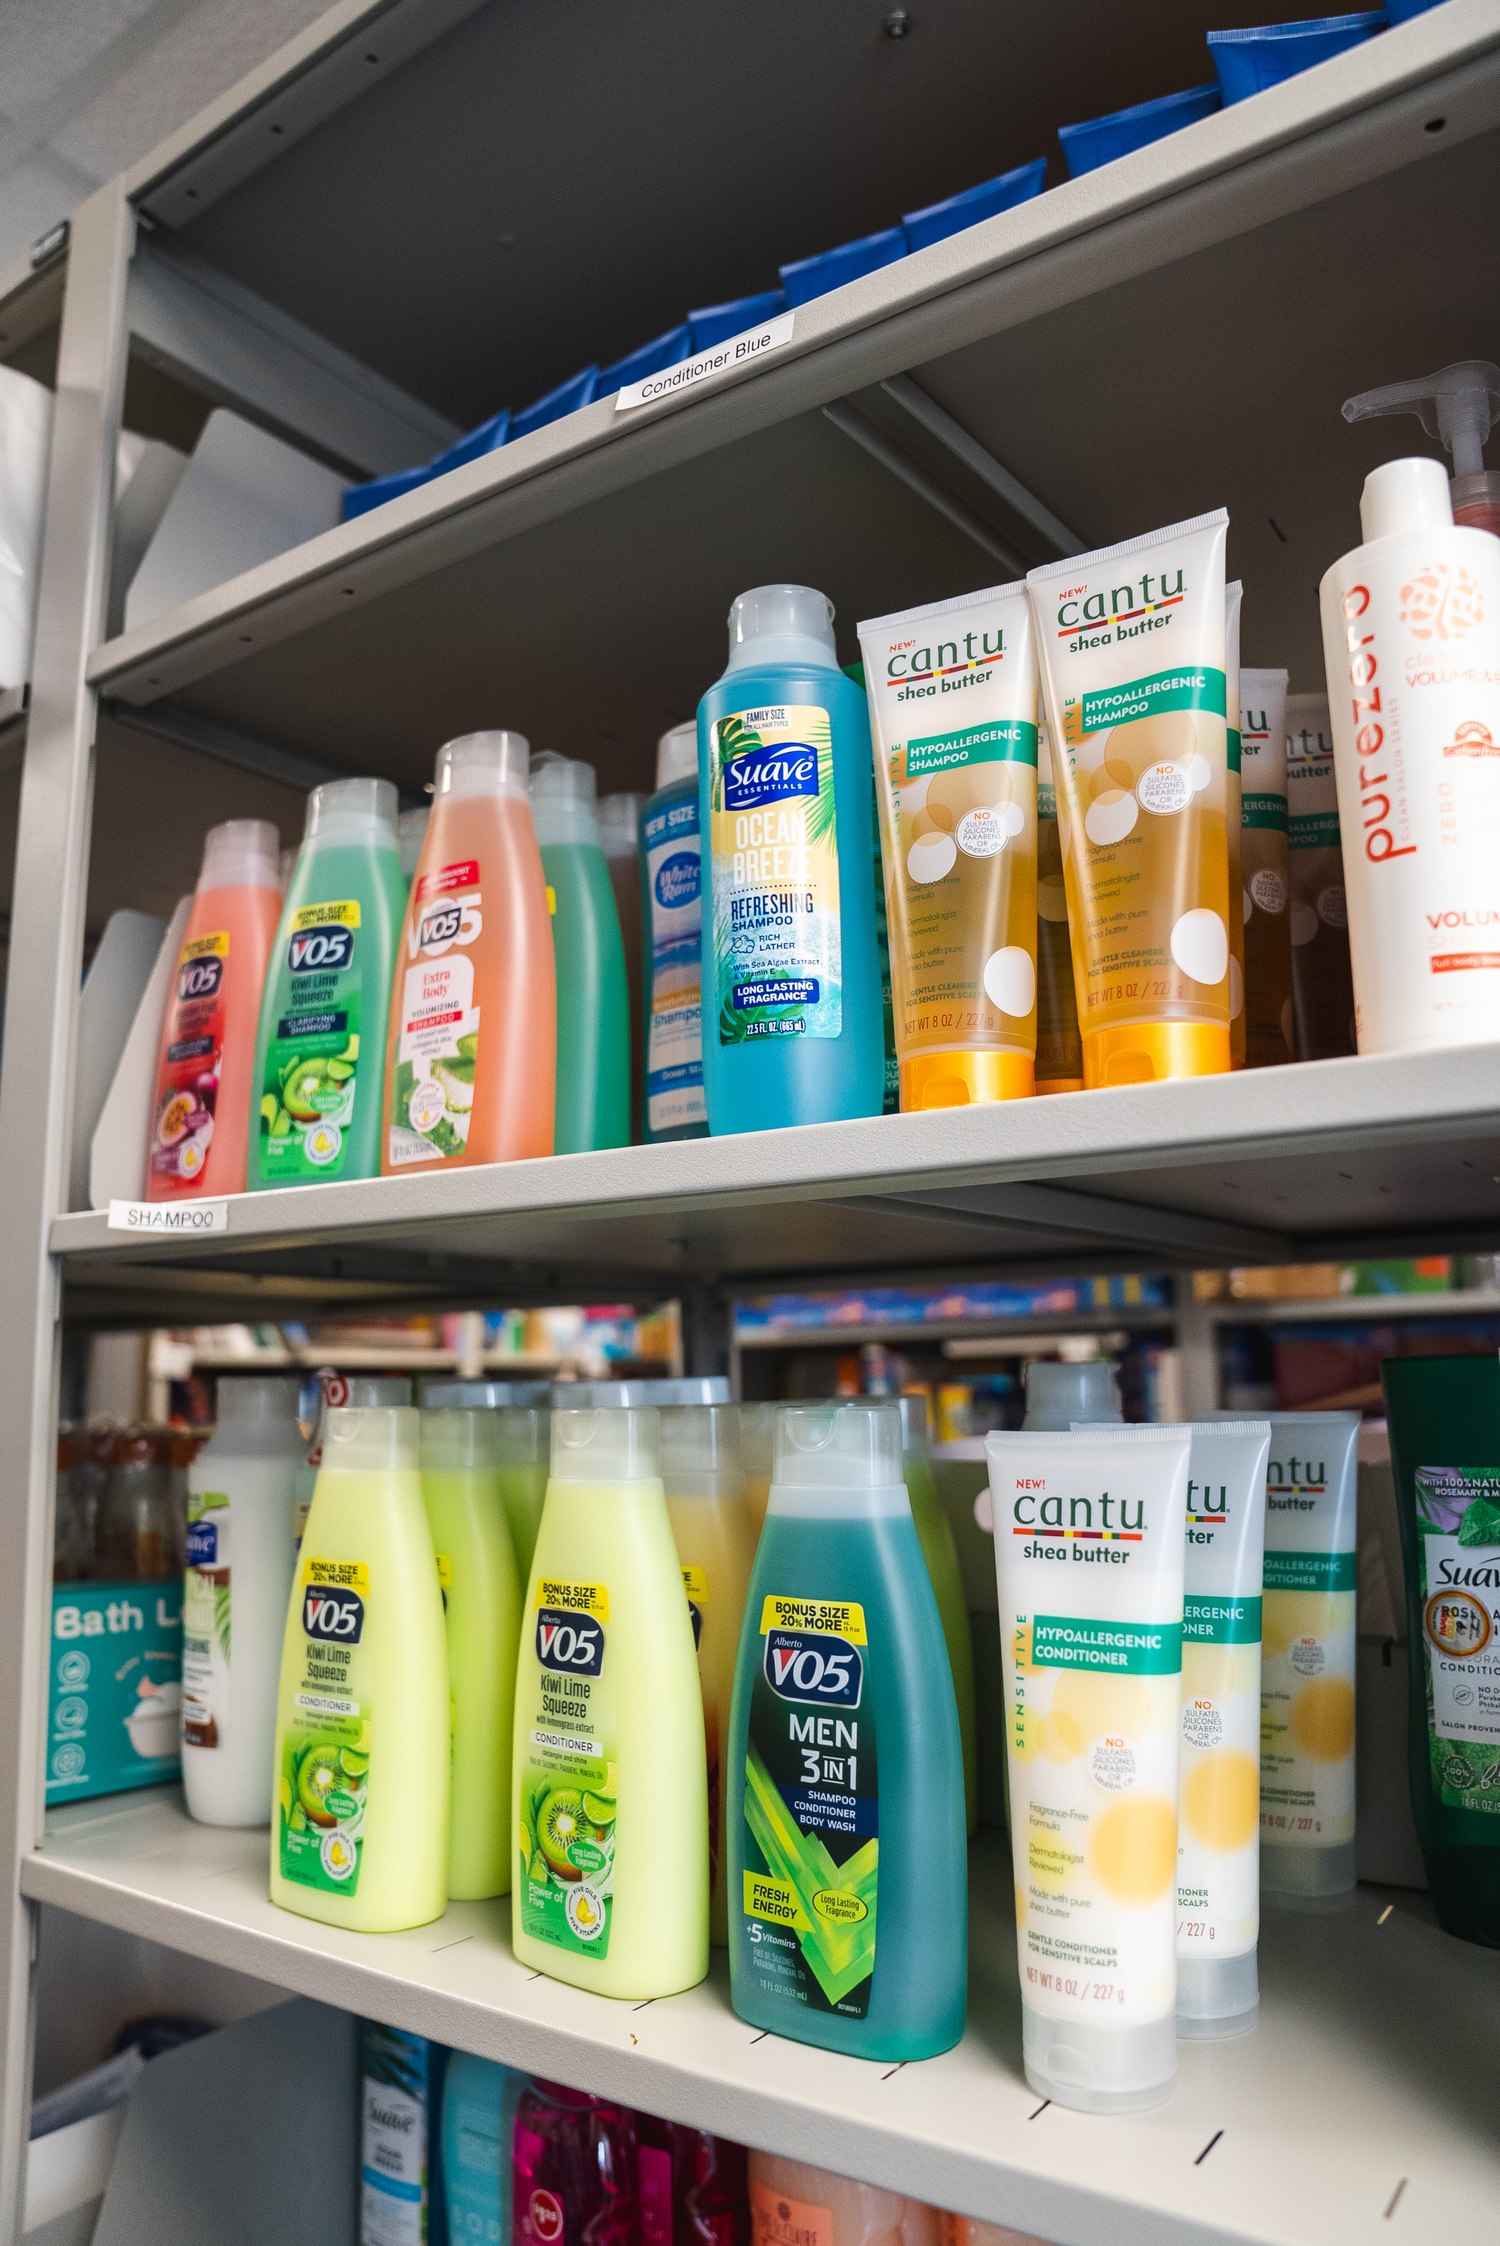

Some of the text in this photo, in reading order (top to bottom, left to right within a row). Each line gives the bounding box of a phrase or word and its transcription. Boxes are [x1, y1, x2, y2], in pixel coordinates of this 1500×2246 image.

[641, 334, 771, 399] Conditioner Blue
[1057, 569, 1184, 628] cantu
[1059, 584, 1088, 600] NEW!
[1069, 613, 1173, 653] shea butter
[887, 629, 1004, 678] cantu
[889, 639, 916, 652] NEW!
[897, 669, 993, 702] shea butter
[1085, 676, 1206, 713] HYPOALLERGENIC
[747, 708, 786, 723] FAMILY SIZE
[1085, 701, 1149, 727] SHAMPOO
[910, 729, 1021, 757] HYPOALLERGENIC
[909, 751, 969, 771] SHAMPOO
[727, 757, 815, 790] Suave
[1156, 766, 1174, 774] NO
[1145, 782, 1185, 790] SILICONES
[1148, 775, 1183, 784] SULFATES
[738, 783, 803, 796] ESSENTIALS
[1144, 789, 1186, 797] PARABENS
[965, 820, 998, 828] SULFATES
[974, 812, 991, 820] NO
[735, 809, 806, 850] OCEAN
[733, 847, 812, 886] BREEZE
[731, 893, 814, 921] REFRESHING
[422, 910, 461, 944] VO5
[732, 916, 793, 932] SHAMPOO
[759, 934, 780, 942] RICH
[292, 934, 350, 968] VO5
[759, 943, 796, 951] LATHER
[767, 959, 789, 969] Algae
[1101, 960, 1140, 975] SENSITIVE
[424, 971, 450, 986] Extra
[423, 985, 449, 1001] Body
[737, 981, 814, 996] LONG LASTING
[1126, 983, 1138, 998] OZ
[743, 991, 808, 1005] FRAGRANCE
[918, 993, 956, 1004] SENSITIVE
[412, 1001, 459, 1018] VOLUMIZING
[412, 1013, 455, 1030] SHAMPOO
[746, 1023, 759, 1035] 22.5
[917, 1013, 984, 1030] WT OZ 227
[128, 1208, 213, 1227] SHAMPOO
[1016, 1479, 1046, 1490] NEW!
[1445, 1477, 1471, 1488] 100%
[1435, 1487, 1482, 1497] ROSEMARY
[1013, 1492, 1144, 1530] cantu
[1268, 1494, 1315, 1512] butter
[1023, 1541, 1130, 1564] shea butter
[311, 1562, 358, 1575] BONUS SIZE
[328, 1574, 352, 1585] MORE
[543, 1582, 596, 1599] BONUS SIZE
[545, 1594, 590, 1609] 20% MORE
[306, 1599, 360, 1635] VO5
[776, 1602, 849, 1619] BONUS SIZE
[54, 1600, 143, 1639] Bath
[541, 1614, 561, 1625] Alberto
[781, 1615, 842, 1631] 20% MORE
[539, 1625, 599, 1665] VO5
[774, 1637, 802, 1648] Alberto
[1036, 1626, 1162, 1650] HYPOALLERGENIC
[306, 1643, 351, 1665] Kiwi Lime
[1035, 1645, 1128, 1666] CONDITIONER
[308, 1661, 347, 1682] Squeeze
[772, 1648, 854, 1693] VO5
[541, 1675, 591, 1699] Kiwi Lime
[1016, 1614, 1027, 1748] SENSITIVE
[300, 1695, 352, 1712] CONDITIONER
[542, 1694, 587, 1718] Squeeze
[1194, 1700, 1212, 1709] NO
[1183, 1717, 1222, 1726] SILICONES
[1185, 1710, 1220, 1719] SULFATES
[547, 1717, 595, 1734] lemongrass extract
[789, 1713, 858, 1750] MEN
[1183, 1724, 1223, 1733] PARABENS
[1441, 1720, 1466, 1731] SALON
[535, 1732, 593, 1753] CONDITIONER
[1105, 1737, 1124, 1748] NO
[1183, 1733, 1212, 1748] MINERAL
[1197, 1732, 1210, 1740] OR
[1094, 1755, 1135, 1765] SILICONES
[1096, 1747, 1133, 1757] SULFATES
[1092, 1763, 1136, 1774] PARABENS
[808, 1790, 856, 1806] SHAMPOO
[794, 1800, 856, 1819] CONDITIONER
[1029, 1801, 1089, 1821] Fragrance-Free
[800, 1814, 856, 1832] BODY WASH
[1029, 1815, 1060, 1831] Formula
[582, 1848, 602, 1862] Lasting
[1029, 1843, 1085, 1864] Dermatologist
[575, 1856, 599, 1870] Fragrance
[1029, 1858, 1064, 1875] Reviewed
[528, 1881, 564, 1904] Power of
[753, 1884, 790, 1904] FRESH
[1029, 1886, 1092, 1910] Made with pure
[528, 1895, 545, 1909] Five
[753, 1898, 798, 1920] ENERGY
[821, 1894, 860, 1910] Long Lasting
[1029, 1901, 1071, 1919] shea butter
[1177, 1898, 1209, 1908] SCALPS
[825, 1904, 856, 1919] Fragrance
[579, 1922, 601, 1937] VITAMINS
[1187, 1922, 1206, 1937] 227
[763, 1932, 796, 1950] vitamins
[1027, 1930, 1118, 1956] GENTLE CONDITIONER
[1027, 1941, 1118, 1968] FOR SENSITIVE SCALPS
[1026, 1965, 1115, 2000] NET WT 8 OZ 227
